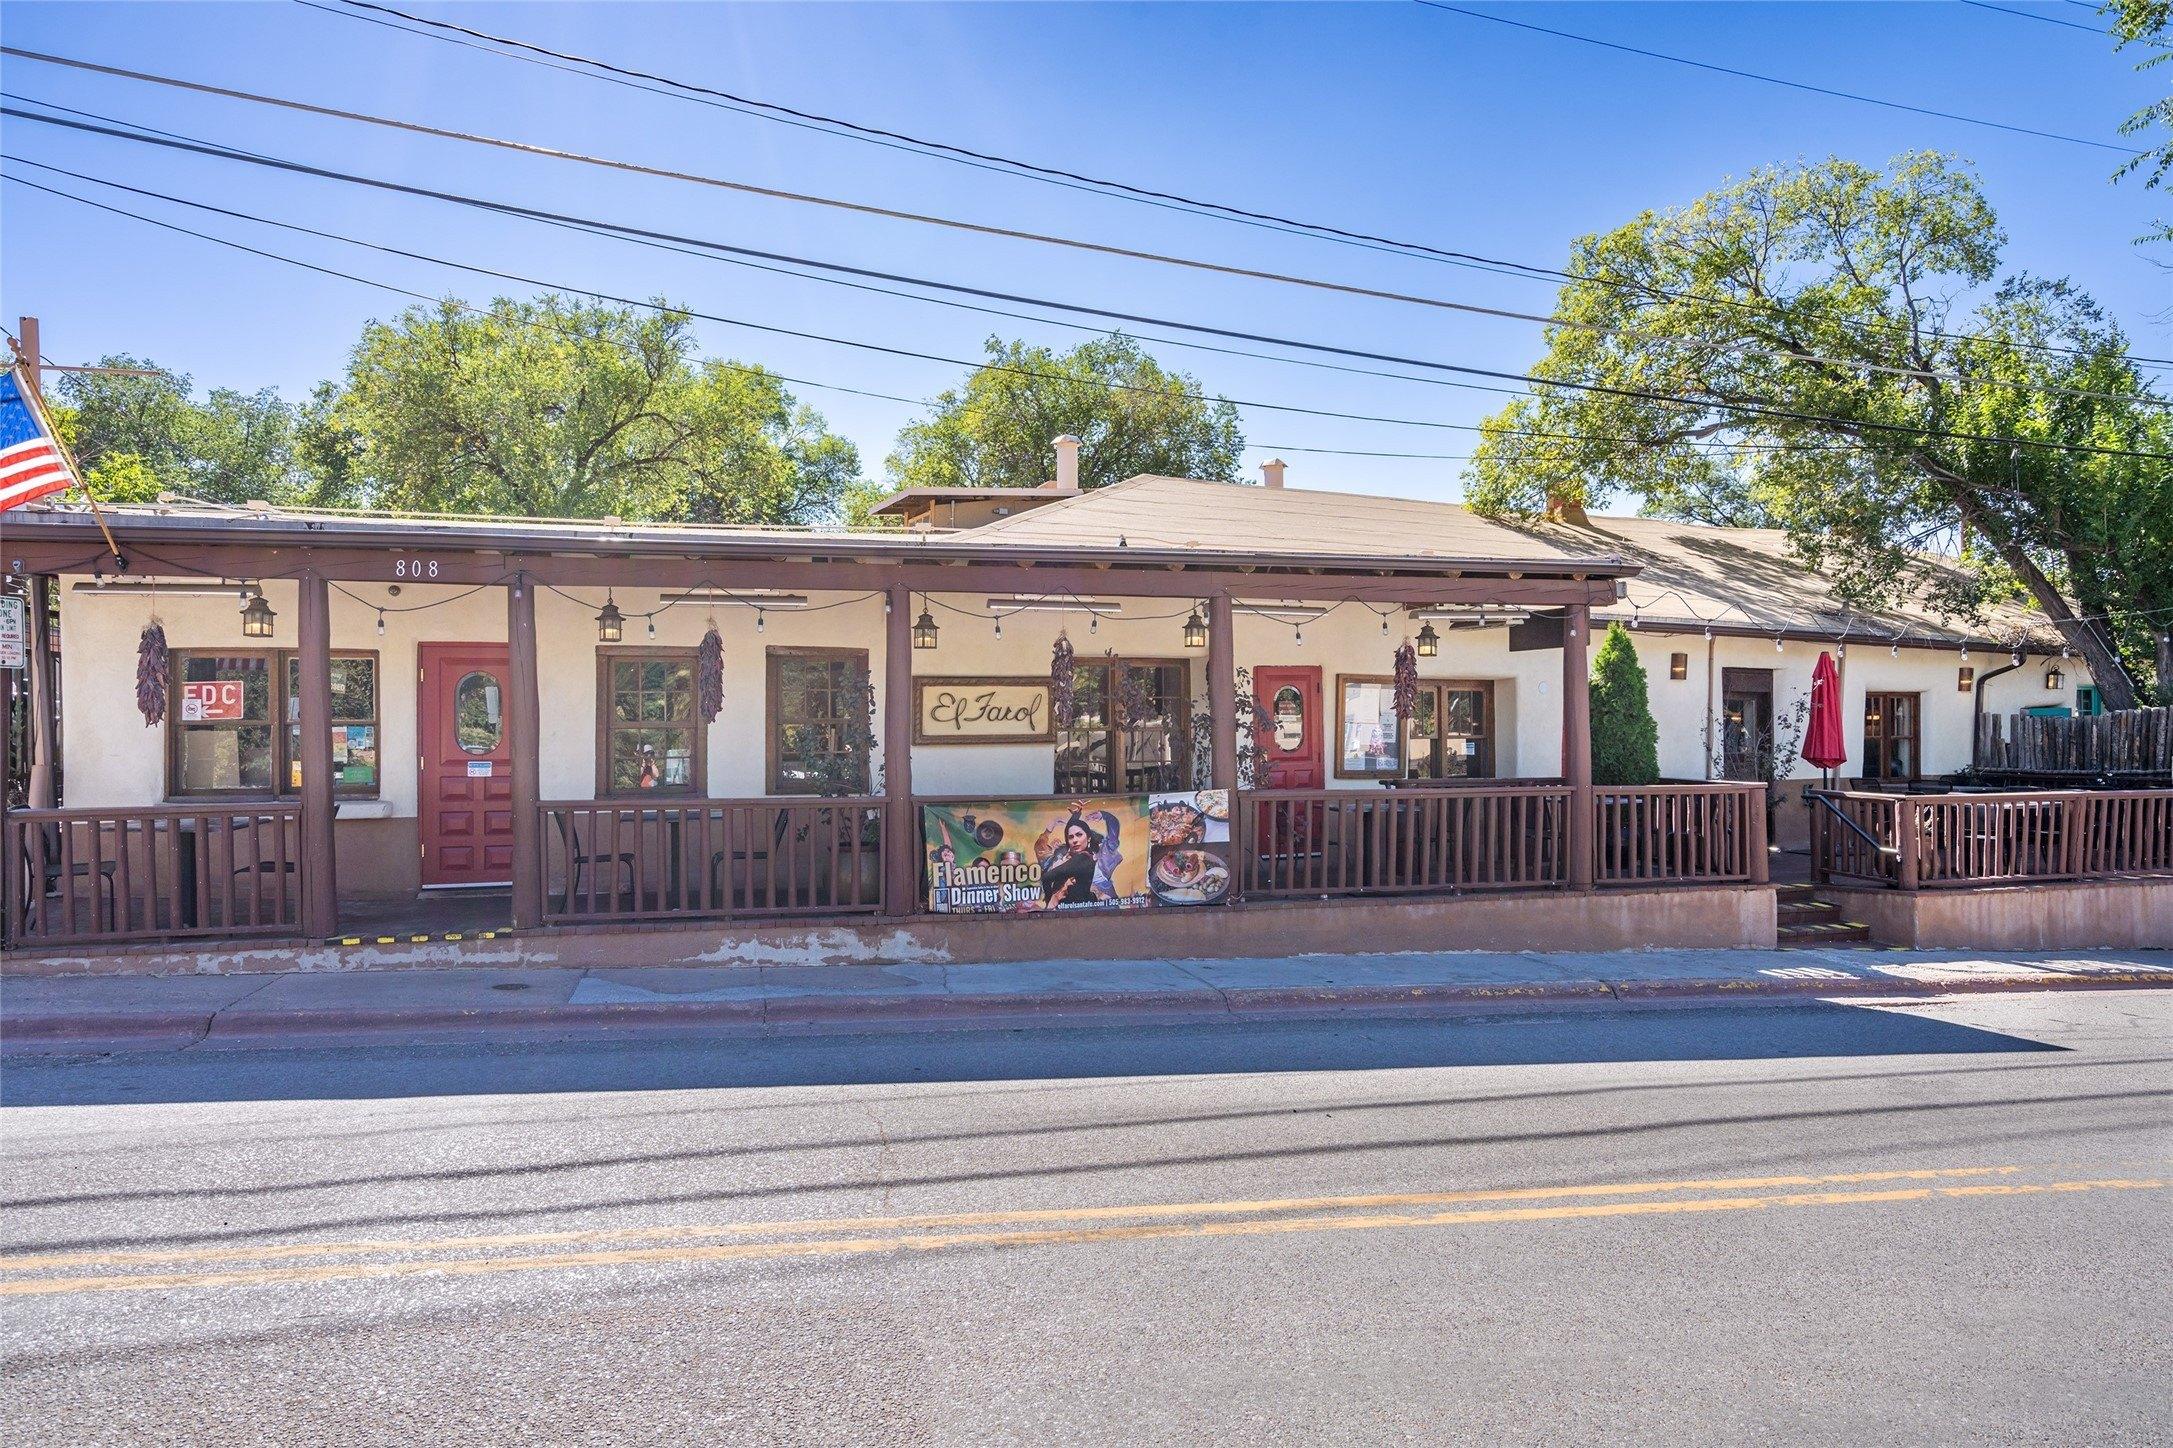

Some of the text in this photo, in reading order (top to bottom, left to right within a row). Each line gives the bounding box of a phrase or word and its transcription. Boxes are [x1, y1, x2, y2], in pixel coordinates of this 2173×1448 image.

[396, 560, 438, 577] 808
[930, 691, 1043, 731] El Farol
[932, 862, 1042, 888] Flamenco
[951, 887, 999, 906] Dinner
[1003, 883, 1041, 902] Show
[984, 904, 996, 913] FRI
